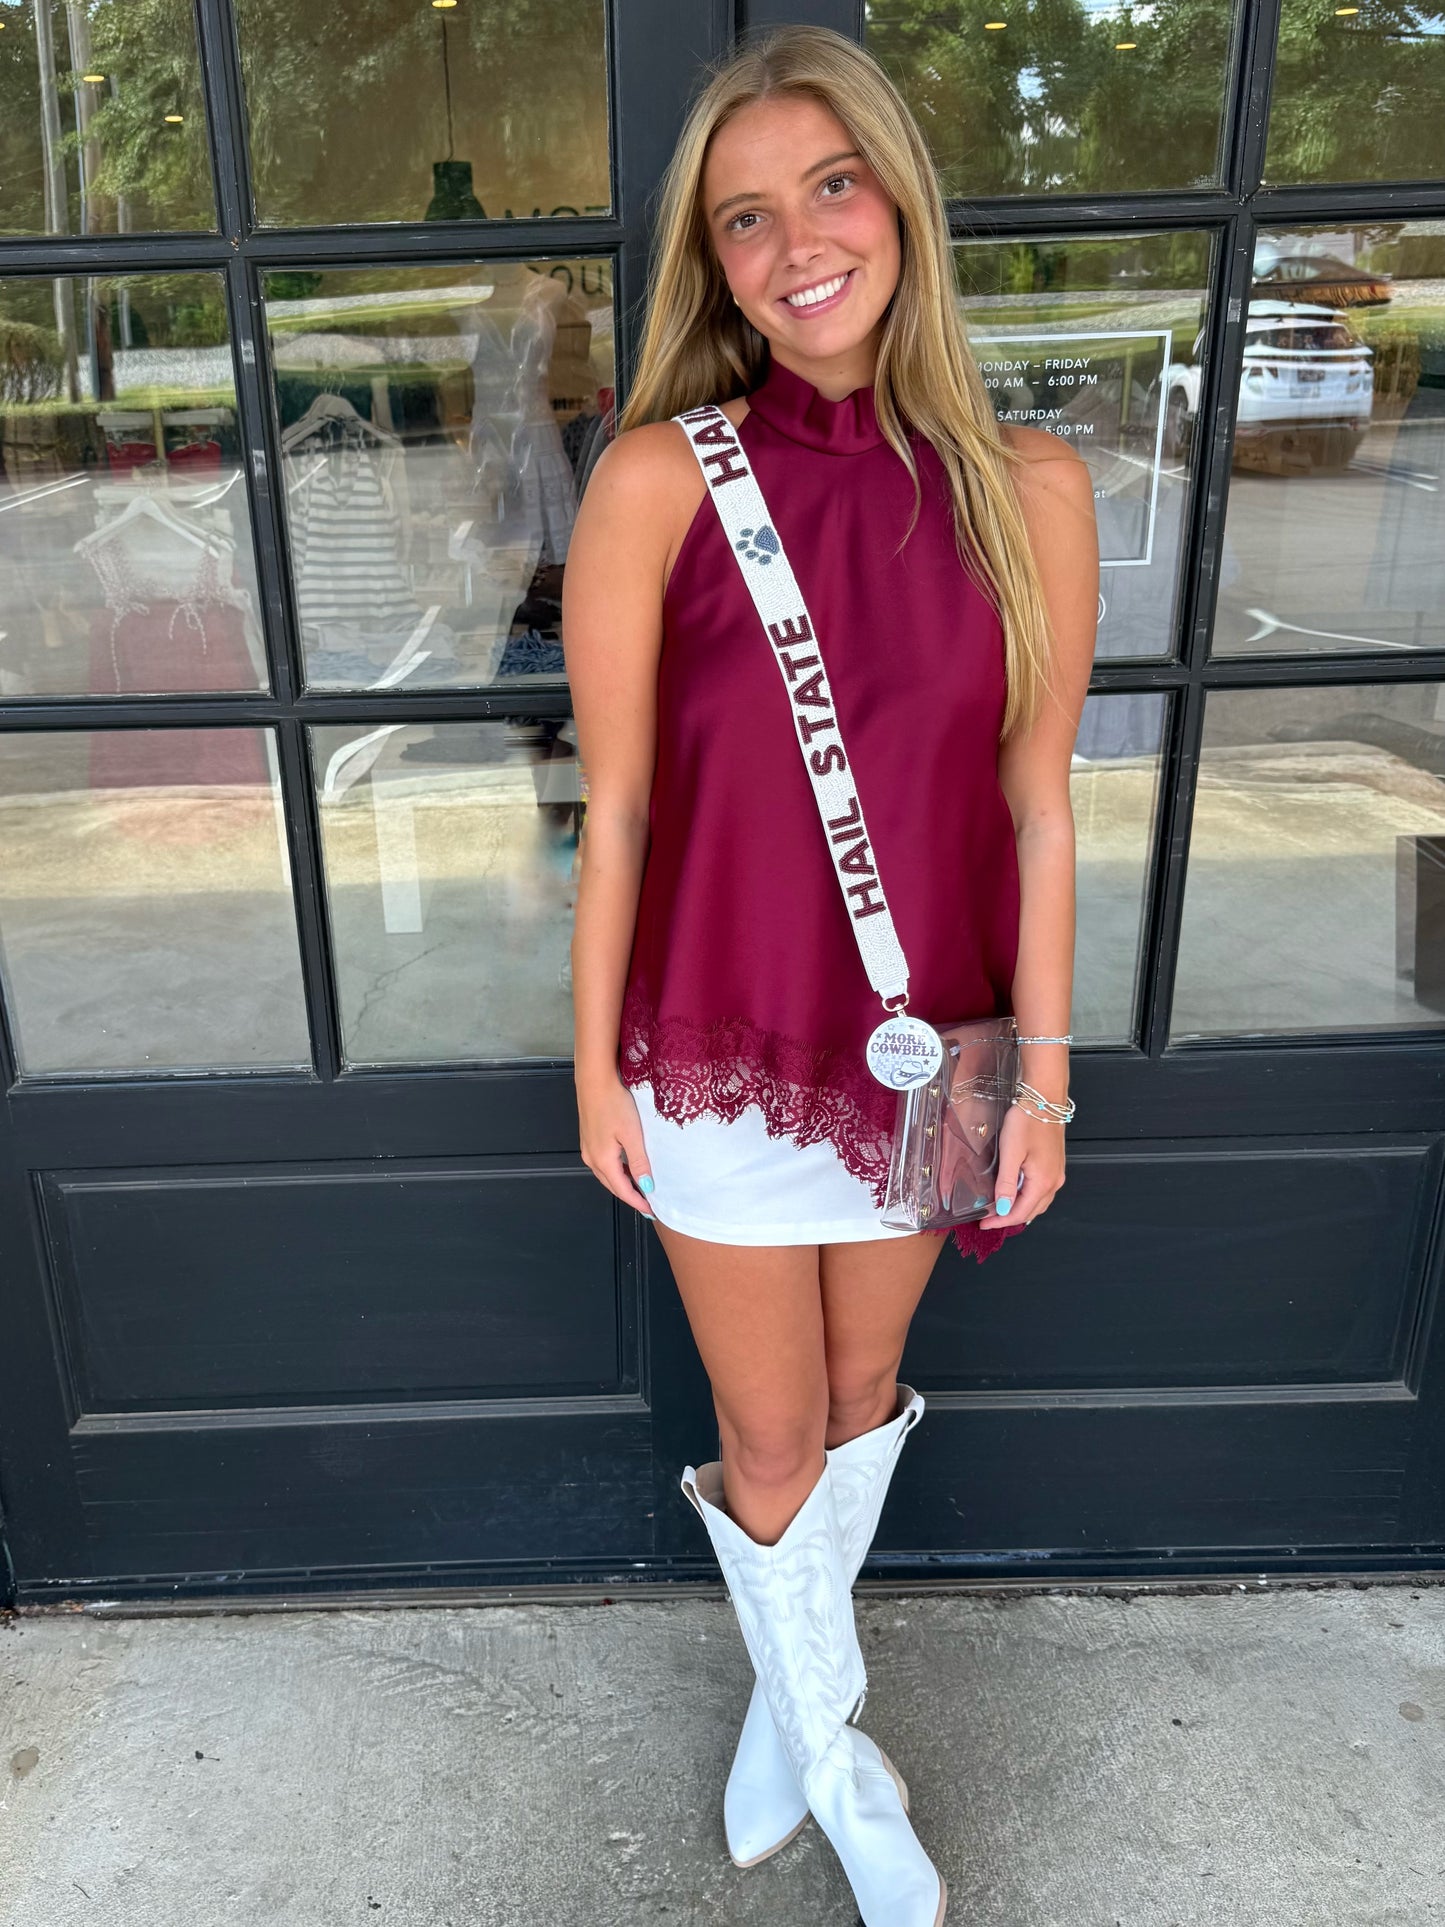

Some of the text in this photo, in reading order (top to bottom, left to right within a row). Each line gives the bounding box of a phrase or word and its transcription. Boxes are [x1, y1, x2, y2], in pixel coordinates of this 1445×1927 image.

[1044, 358, 1091, 370] FRIDAY
[984, 378, 999, 389] 00
[1003, 377, 1024, 388] AM
[1047, 375, 1075, 387] 6:00
[1079, 374, 1098, 386] PM
[997, 409, 1063, 422] SATURDAY
[1045, 424, 1094, 436] 5:00 PM
[680, 406, 749, 488] HAIL
[768, 614, 887, 920] HAIL STATE
[884, 1032, 926, 1046] MORE
[870, 1042, 939, 1057] COWBELL
